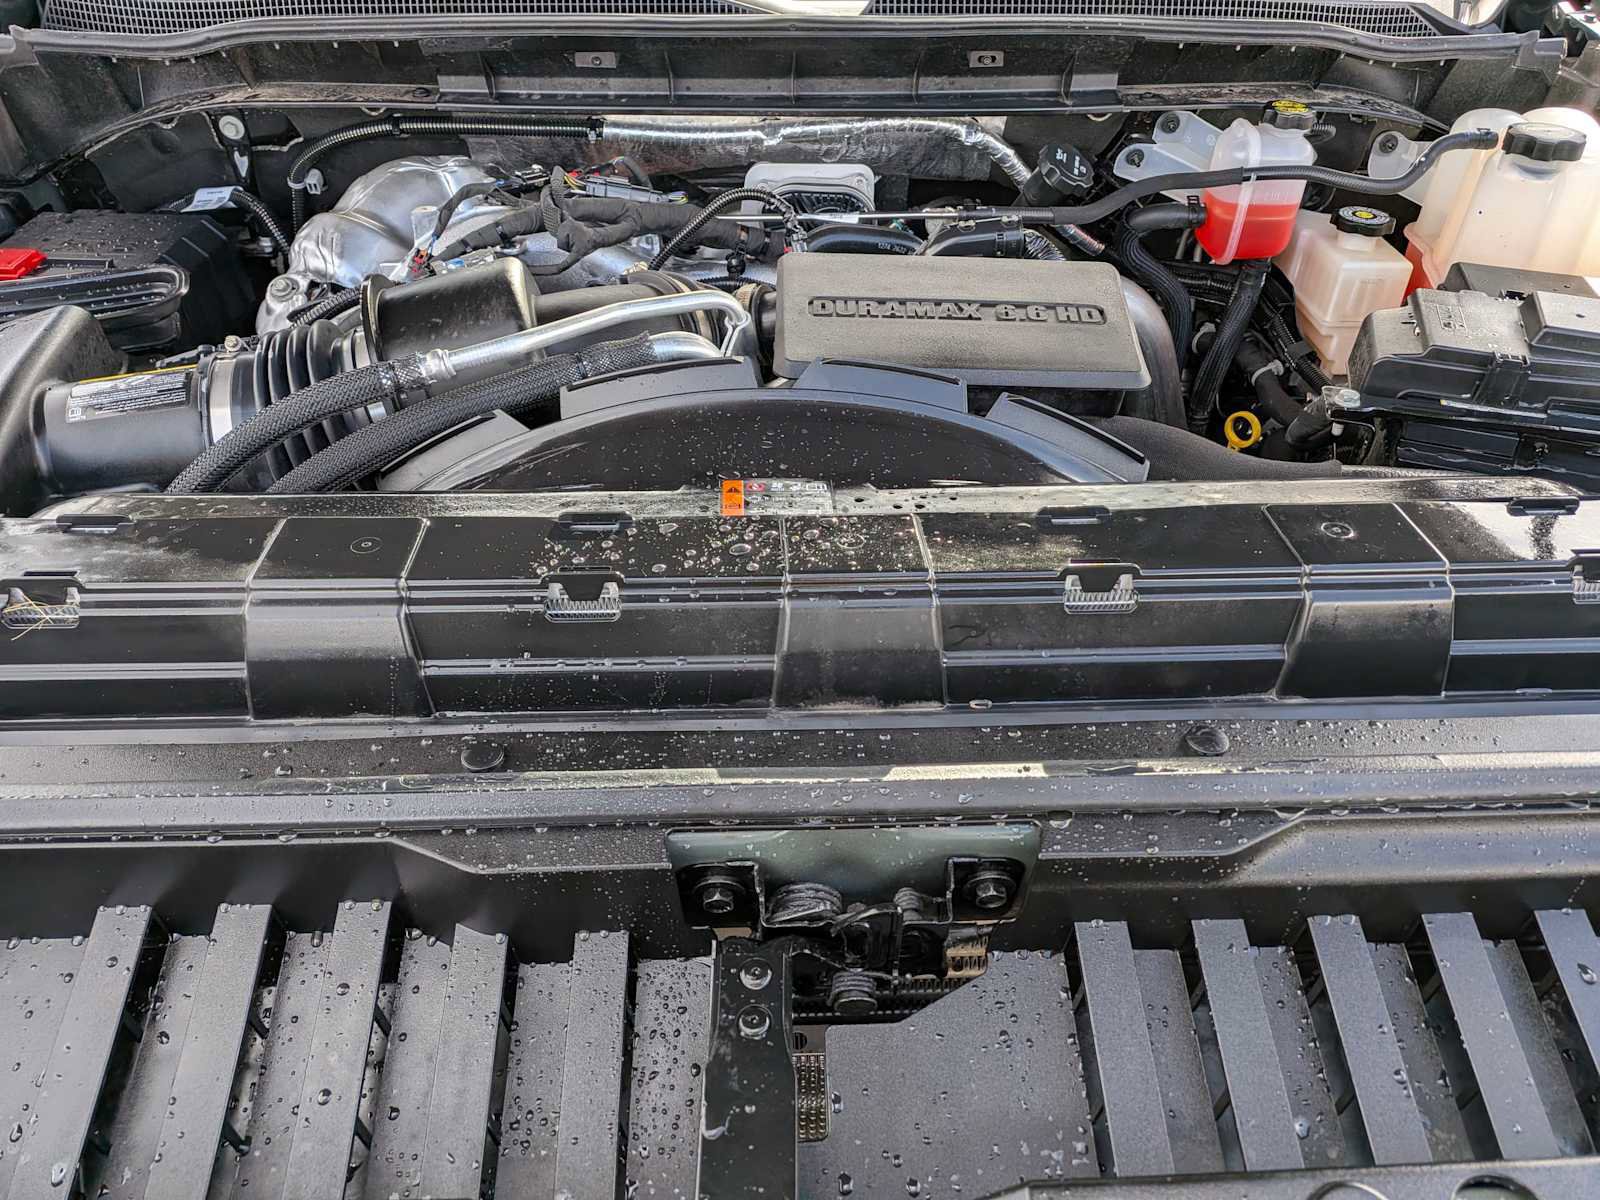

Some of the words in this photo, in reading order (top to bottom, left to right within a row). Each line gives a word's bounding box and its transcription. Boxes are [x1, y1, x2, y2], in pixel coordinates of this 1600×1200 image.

[812, 300, 982, 319] DURAMAX
[996, 304, 1048, 321] 6.6
[1056, 306, 1104, 323] HD
